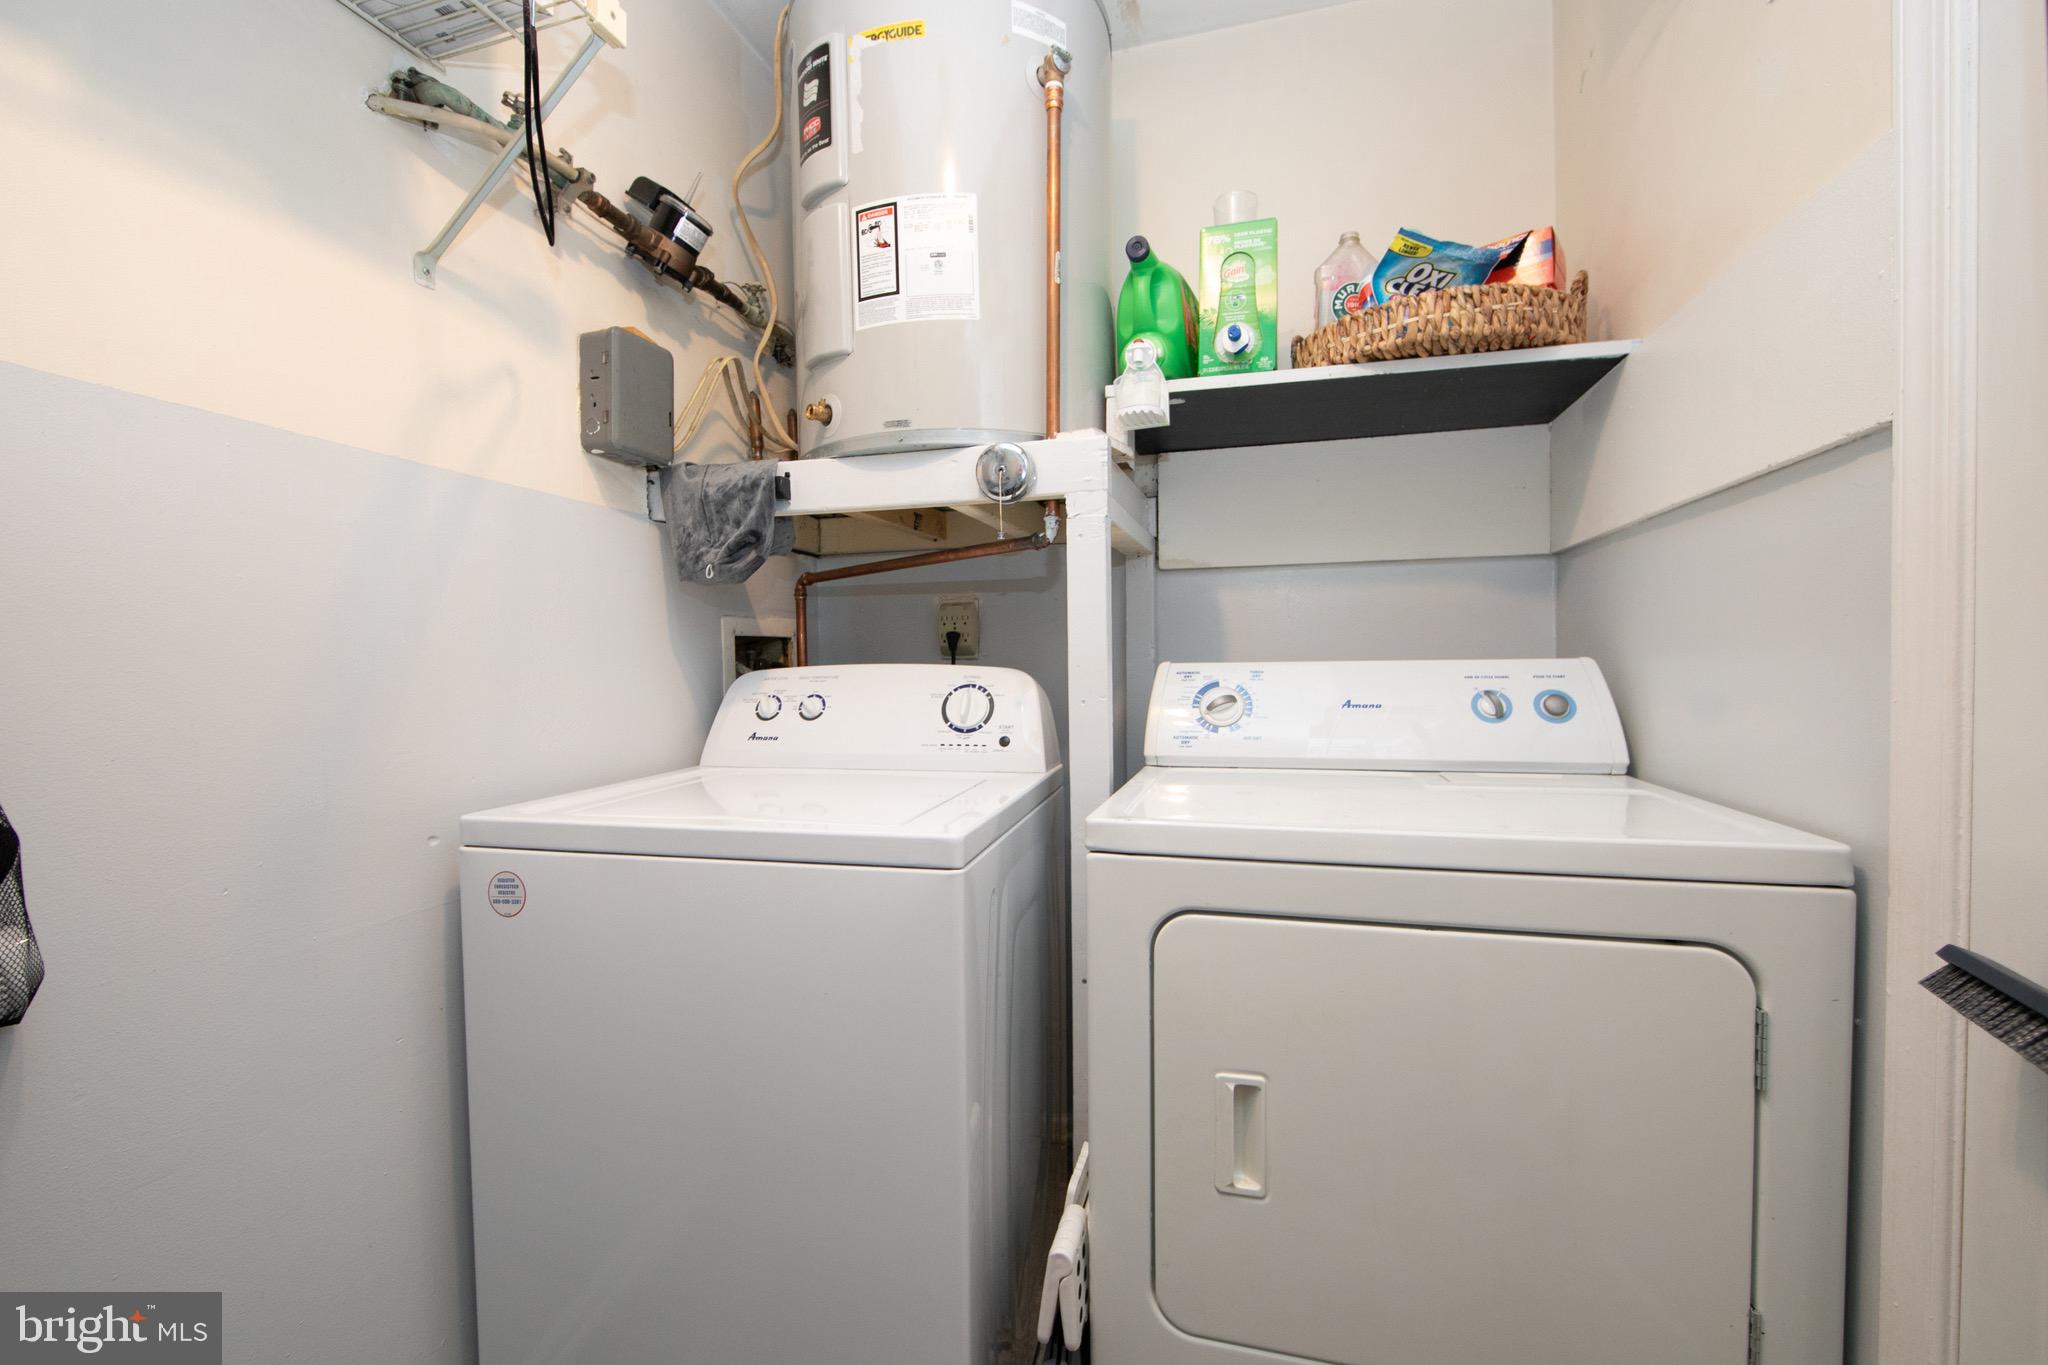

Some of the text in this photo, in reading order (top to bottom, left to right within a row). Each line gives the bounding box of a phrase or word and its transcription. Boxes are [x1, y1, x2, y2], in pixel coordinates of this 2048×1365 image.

[1406, 262, 1457, 289] OXI
[1341, 699, 1383, 709] Amana
[747, 732, 779, 741] Amana
